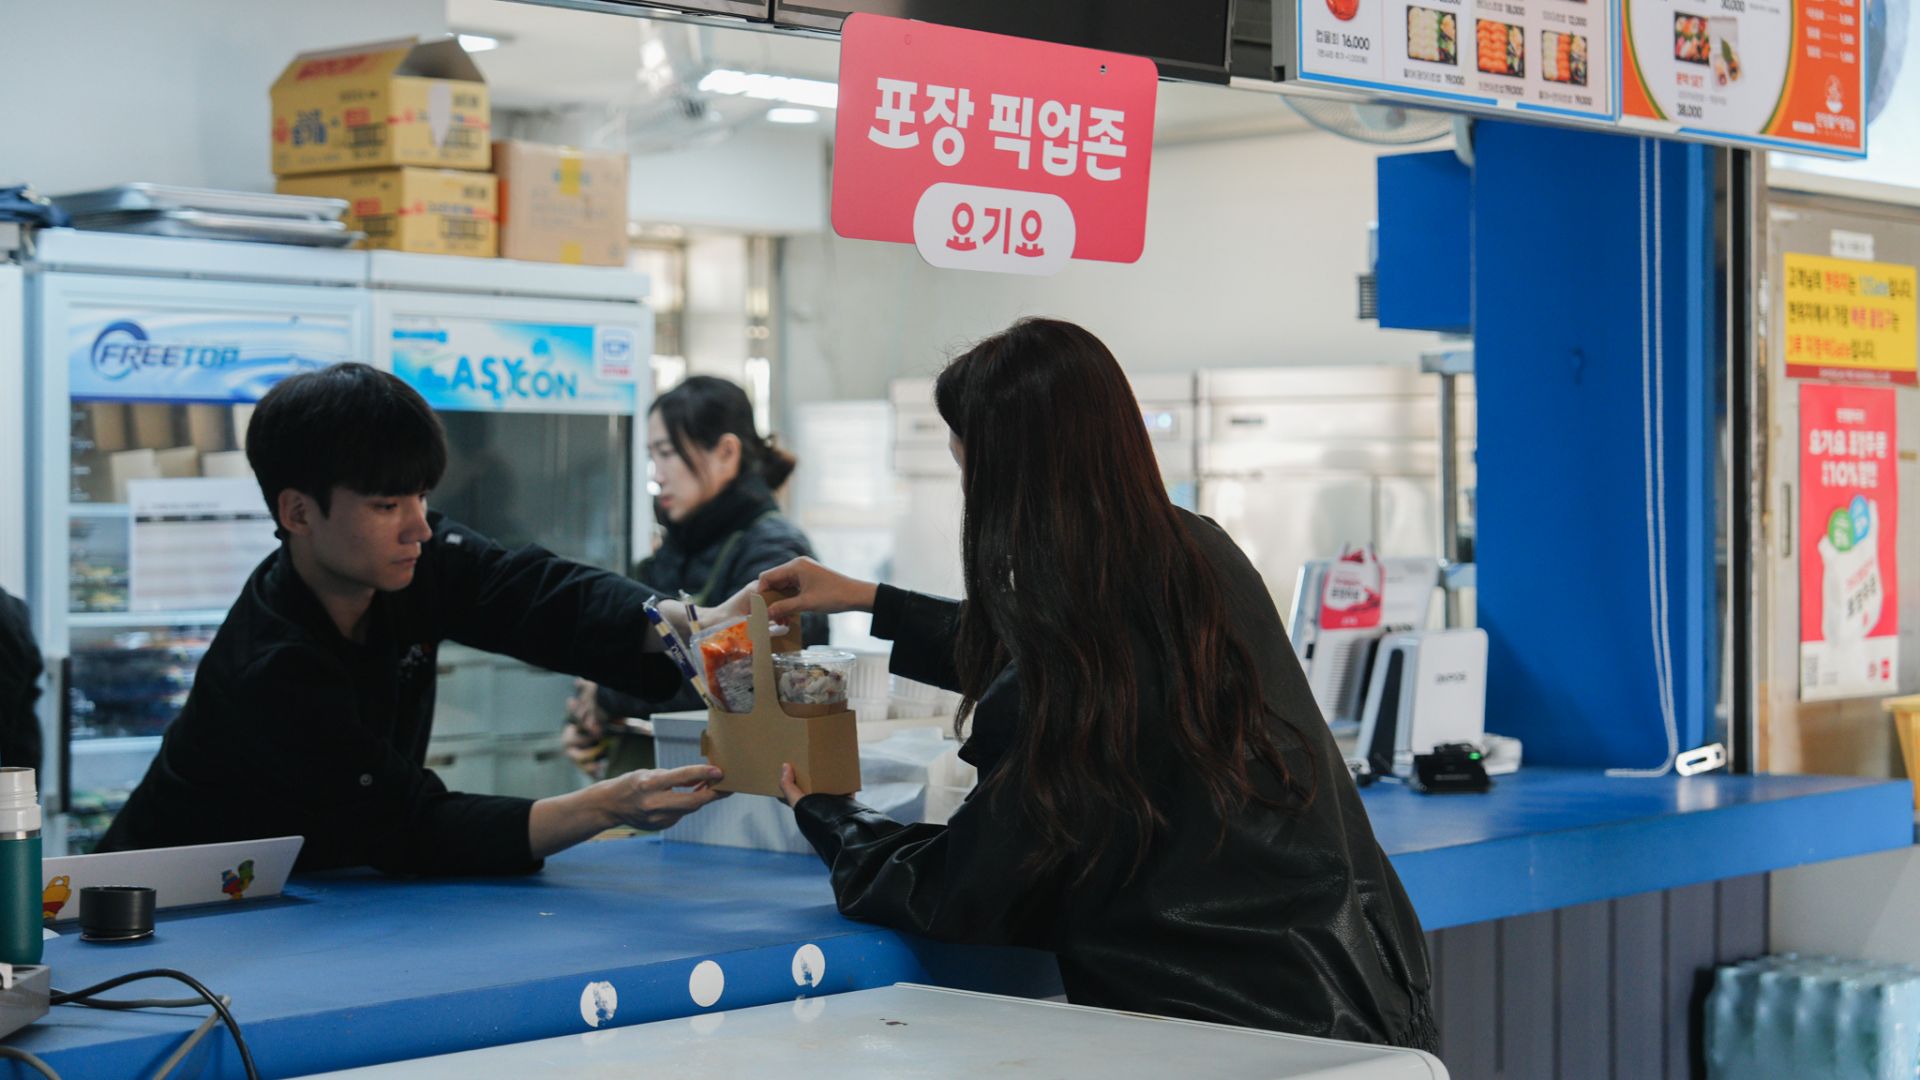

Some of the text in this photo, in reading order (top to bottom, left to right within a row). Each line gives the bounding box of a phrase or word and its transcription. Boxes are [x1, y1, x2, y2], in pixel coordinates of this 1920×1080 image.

[1342, 33, 1370, 51] 16,000
[867, 77, 1127, 181] 포장 픽업존
[945, 202, 1045, 257] 요기요
[98, 343, 240, 370] FREETOP
[1809, 429, 1845, 455] 요기요
